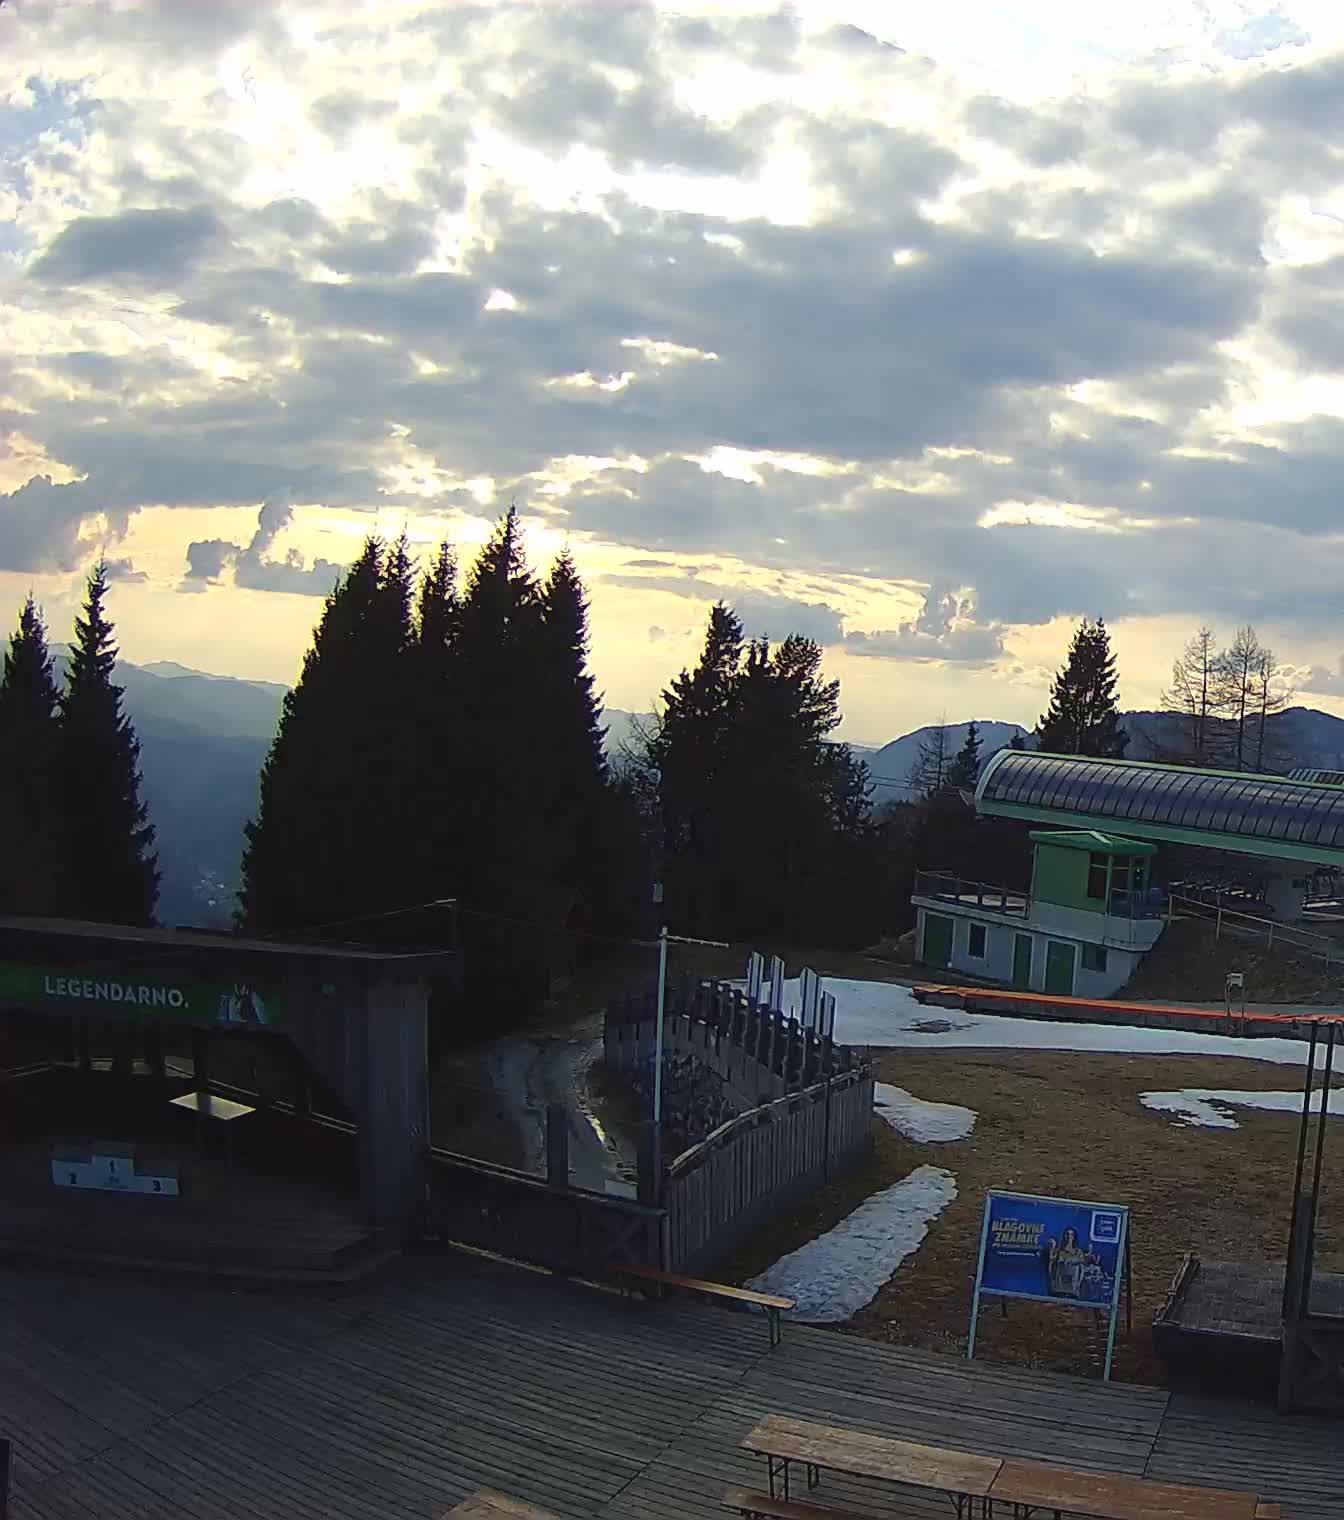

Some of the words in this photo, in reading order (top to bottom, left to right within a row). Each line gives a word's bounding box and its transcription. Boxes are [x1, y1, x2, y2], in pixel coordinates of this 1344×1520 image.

[44, 975, 190, 1009] LEGENDARNO.
[992, 1220, 1046, 1233] BLAGOVNE
[994, 1231, 1041, 1244] ZNAMKE
